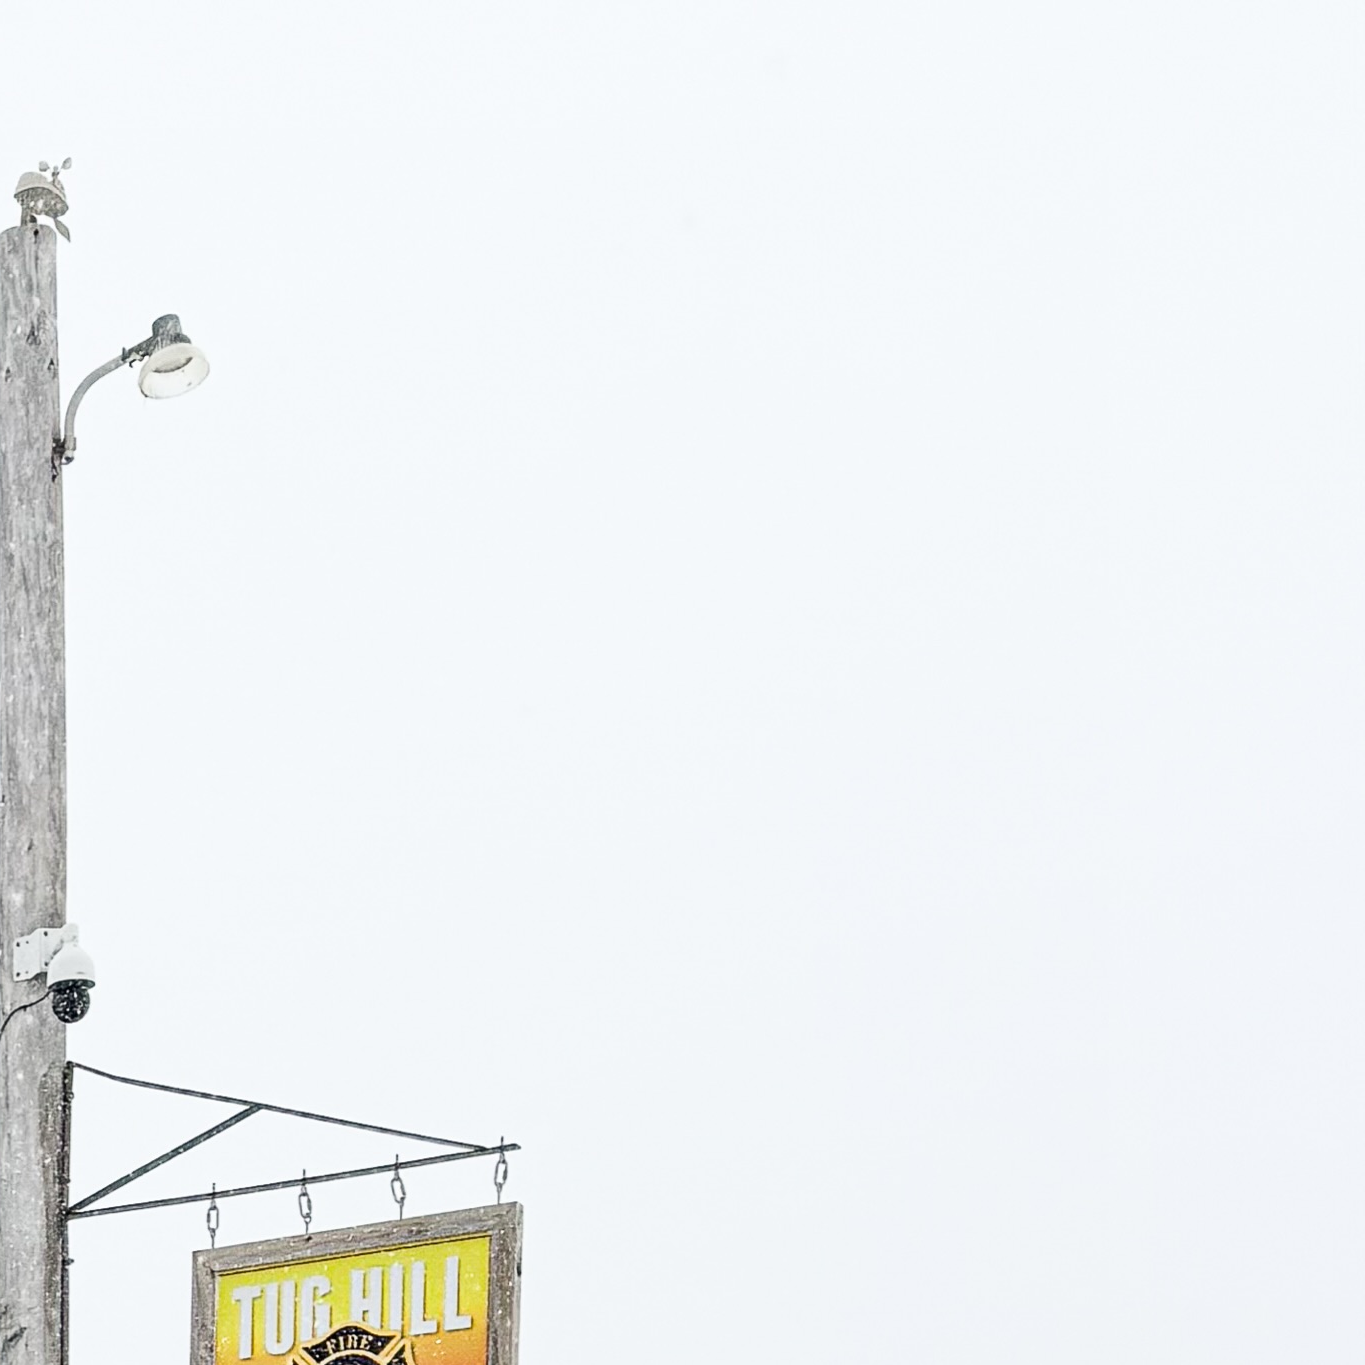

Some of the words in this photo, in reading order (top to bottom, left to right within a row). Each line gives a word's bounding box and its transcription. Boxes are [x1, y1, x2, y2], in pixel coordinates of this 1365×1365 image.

[232, 1274, 332, 1360] TUG
[349, 1255, 472, 1337] HILL
[324, 1333, 373, 1354] FIRE
